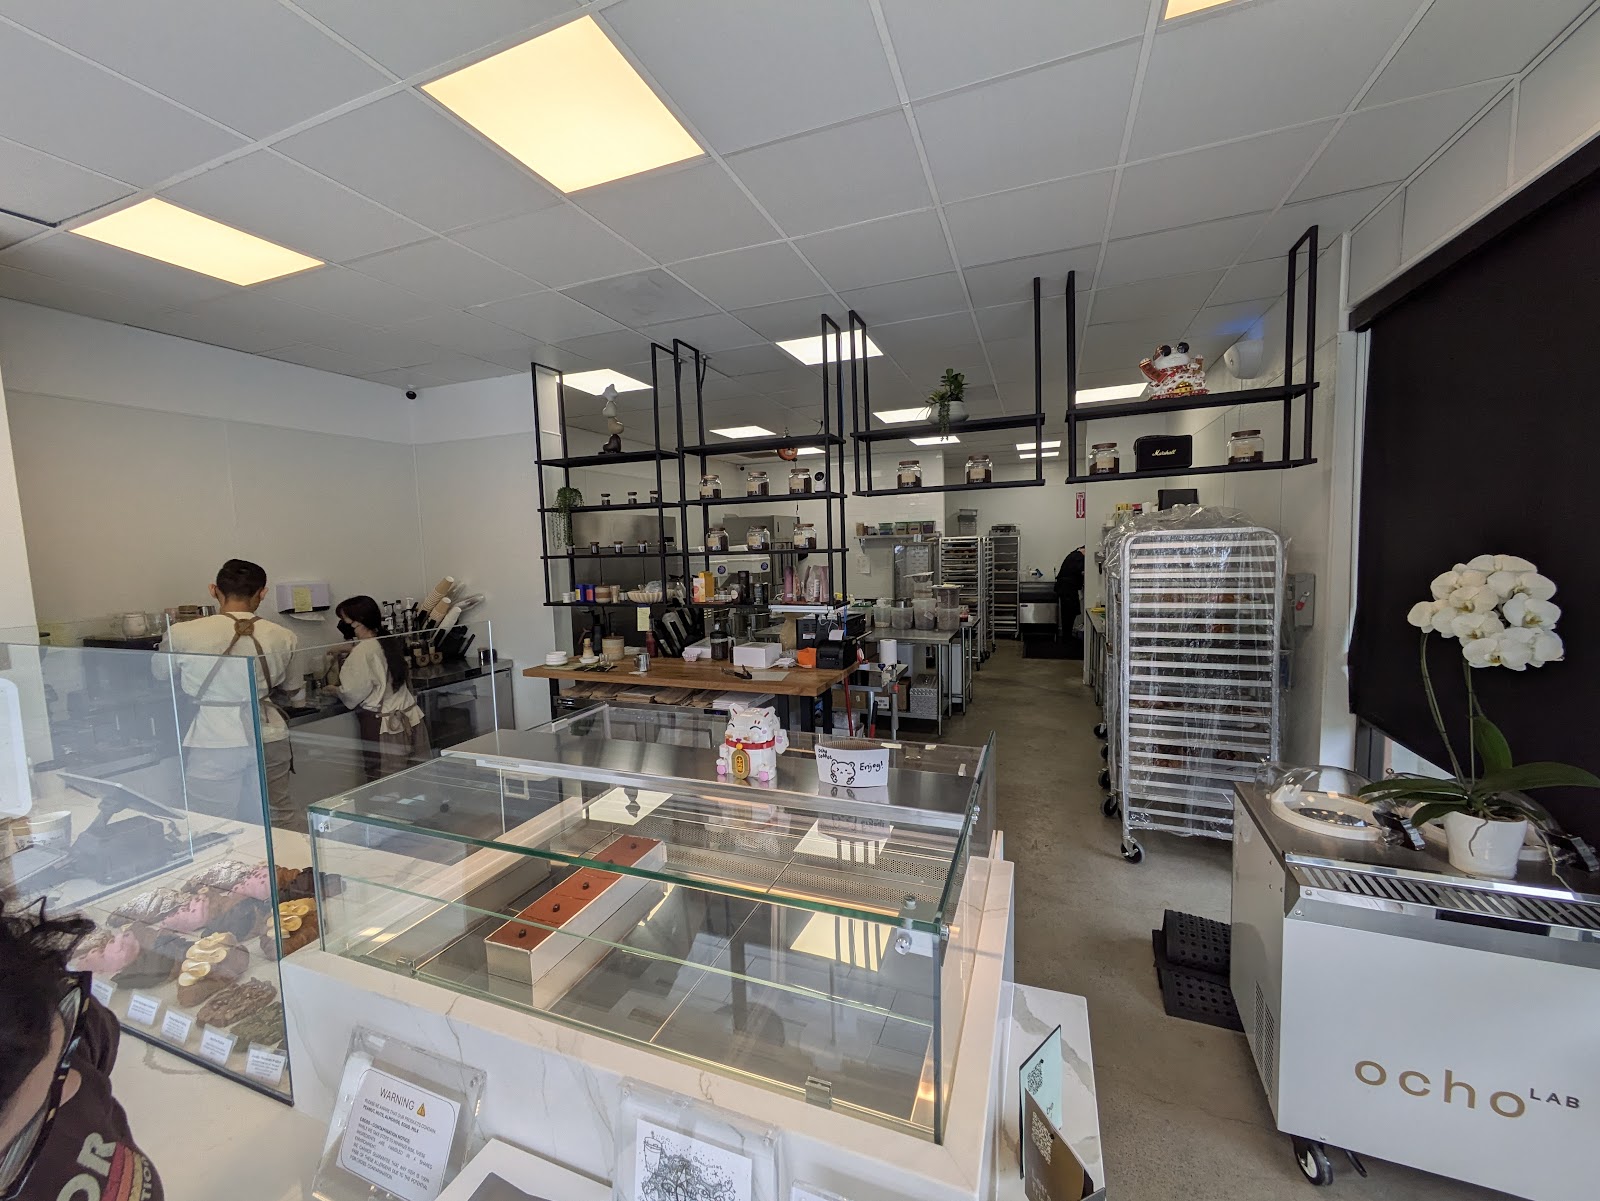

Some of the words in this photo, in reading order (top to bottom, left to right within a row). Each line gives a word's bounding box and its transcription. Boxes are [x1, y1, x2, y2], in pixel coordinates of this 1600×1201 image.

[860, 760, 884, 773] Enjoy!
[380, 1087, 415, 1111] WARNING
[1354, 1060, 1526, 1118] ocho
[1530, 1088, 1580, 1109] LAB
